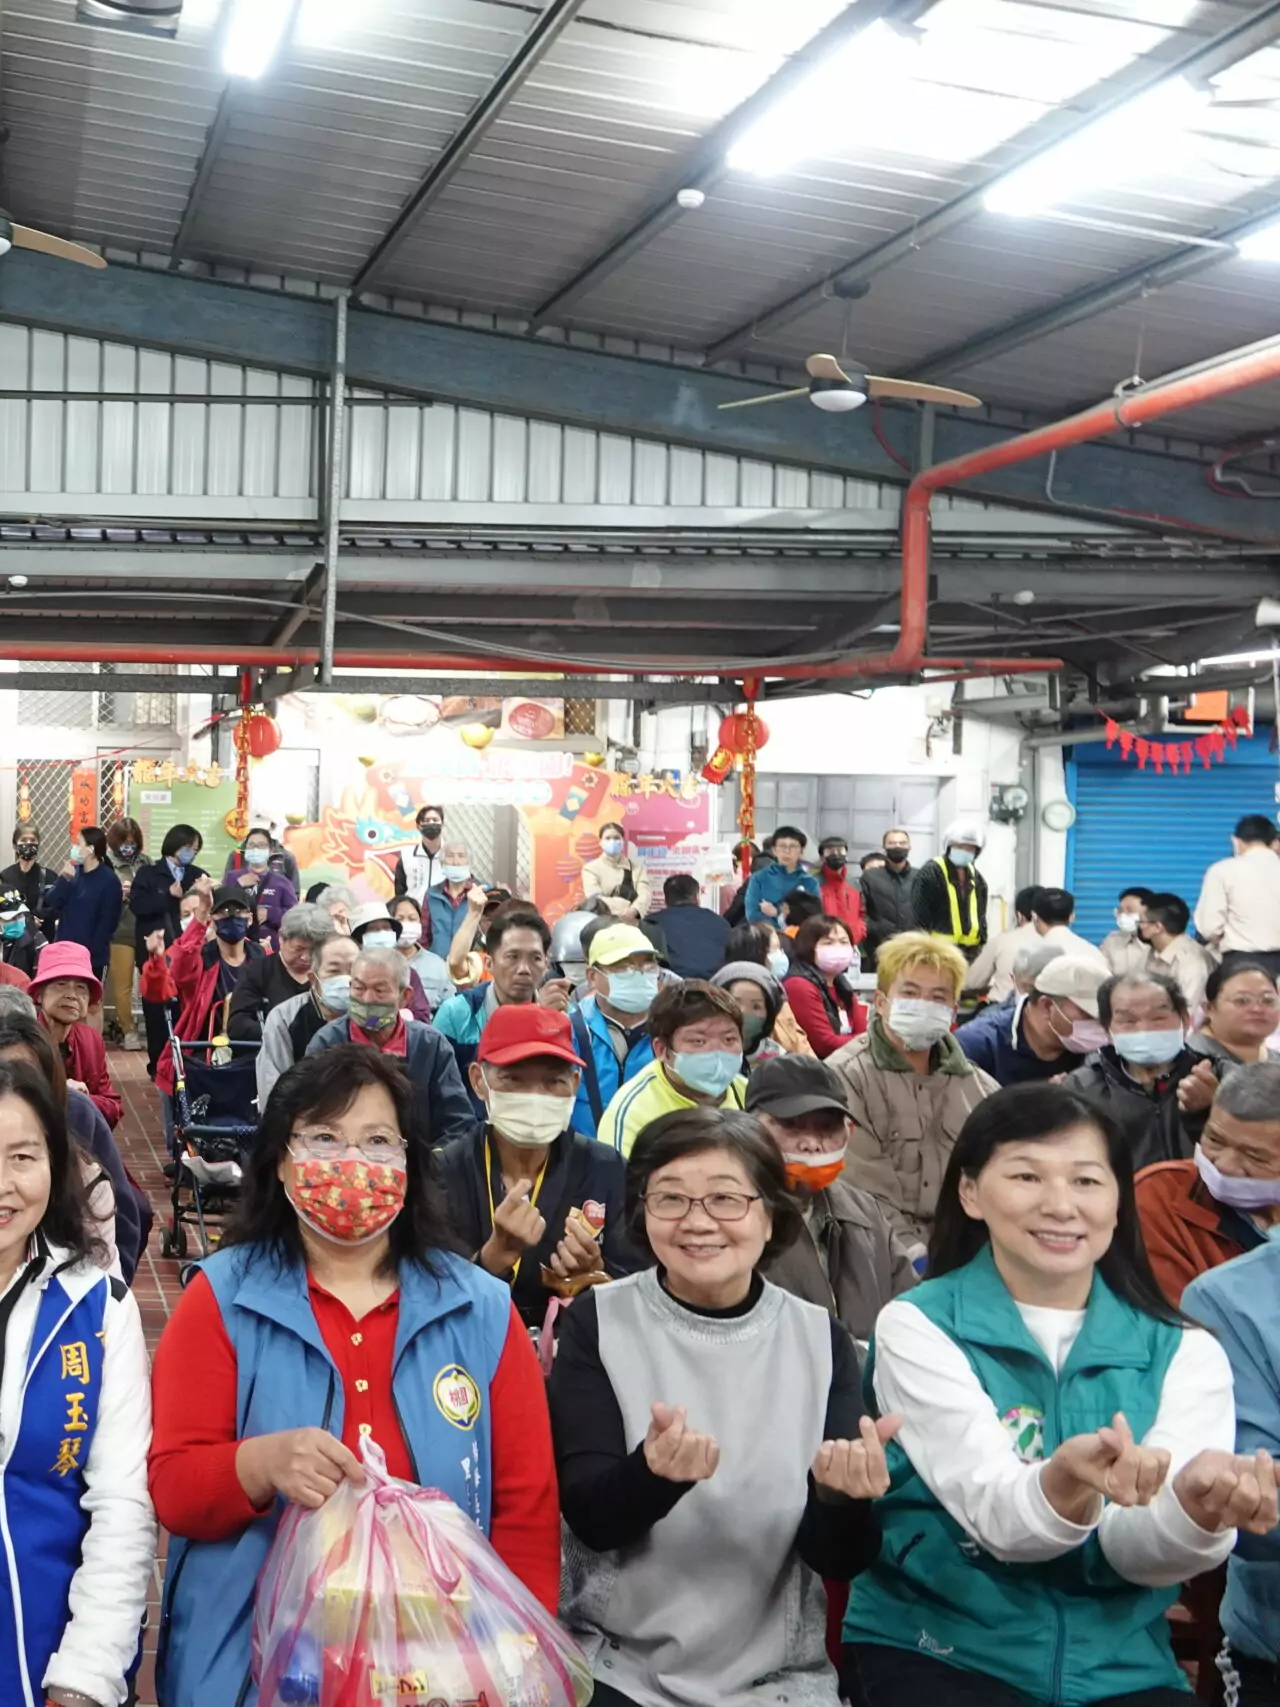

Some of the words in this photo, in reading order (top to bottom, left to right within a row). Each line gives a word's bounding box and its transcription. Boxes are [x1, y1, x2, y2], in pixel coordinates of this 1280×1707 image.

[132, 757, 222, 788] 龍年大吉
[48, 1340, 91, 1478] 周玉琴
